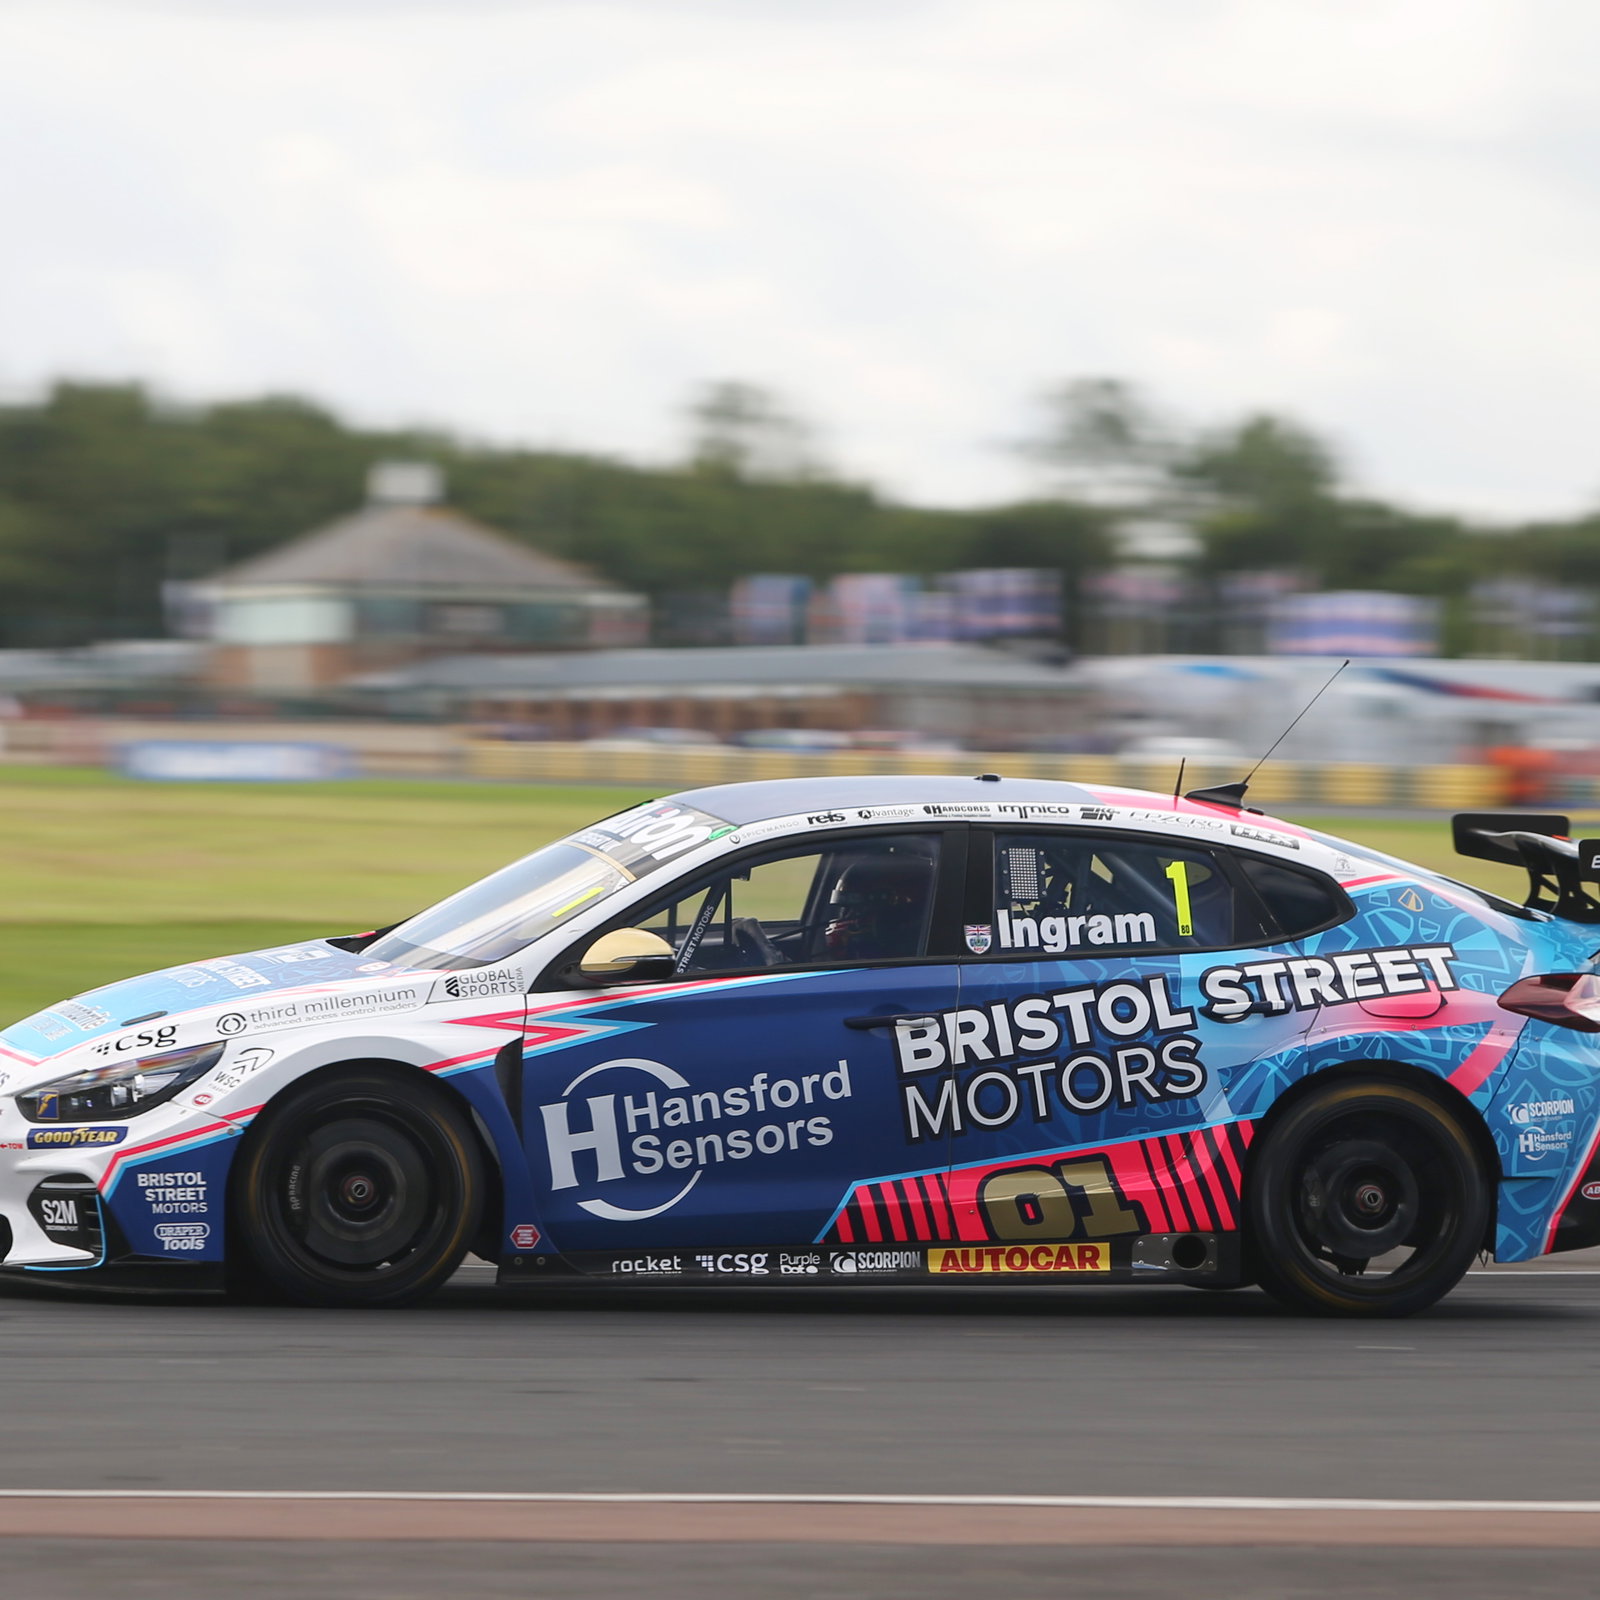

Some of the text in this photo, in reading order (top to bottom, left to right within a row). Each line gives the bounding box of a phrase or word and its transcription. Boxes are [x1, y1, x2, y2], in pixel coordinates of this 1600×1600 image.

[807, 811, 846, 825] reis
[931, 804, 991, 814] HARDCORES
[997, 804, 1070, 819] immico
[1165, 861, 1193, 936] 1
[676, 904, 715, 974] STREET MOTORS
[996, 908, 1157, 954] Ingram
[459, 968, 515, 984] GLOBAL
[516, 967, 526, 992] MEDIA
[460, 981, 517, 998] SPORTS
[250, 988, 417, 1023] third millennium
[896, 946, 1456, 1073] BRISTOL STREET
[254, 1001, 418, 1030] advanced access control readers
[115, 1024, 181, 1051] csg
[214, 1071, 241, 1088] WSC
[905, 1037, 1204, 1139] MOTORS
[624, 1059, 853, 1134] Hansford
[1529, 1098, 1575, 1117] SCORPION
[631, 1115, 834, 1175] Sensors
[1534, 1131, 1572, 1142] Hansford
[1535, 1142, 1568, 1152] Sensors
[137, 1171, 207, 1187] BRISTOL
[145, 1187, 207, 1201] STREET
[984, 1159, 1141, 1241] 01
[41, 1199, 78, 1225] S2M
[152, 1202, 208, 1214] MOTORS
[159, 1226, 205, 1236] DRAPER
[161, 1236, 206, 1250] Tools
[611, 1255, 683, 1273] rocket
[717, 1252, 770, 1275] csg
[779, 1252, 821, 1267] Purple
[858, 1251, 921, 1269] SCORPION
[939, 1245, 1101, 1274] AUTOCAR
